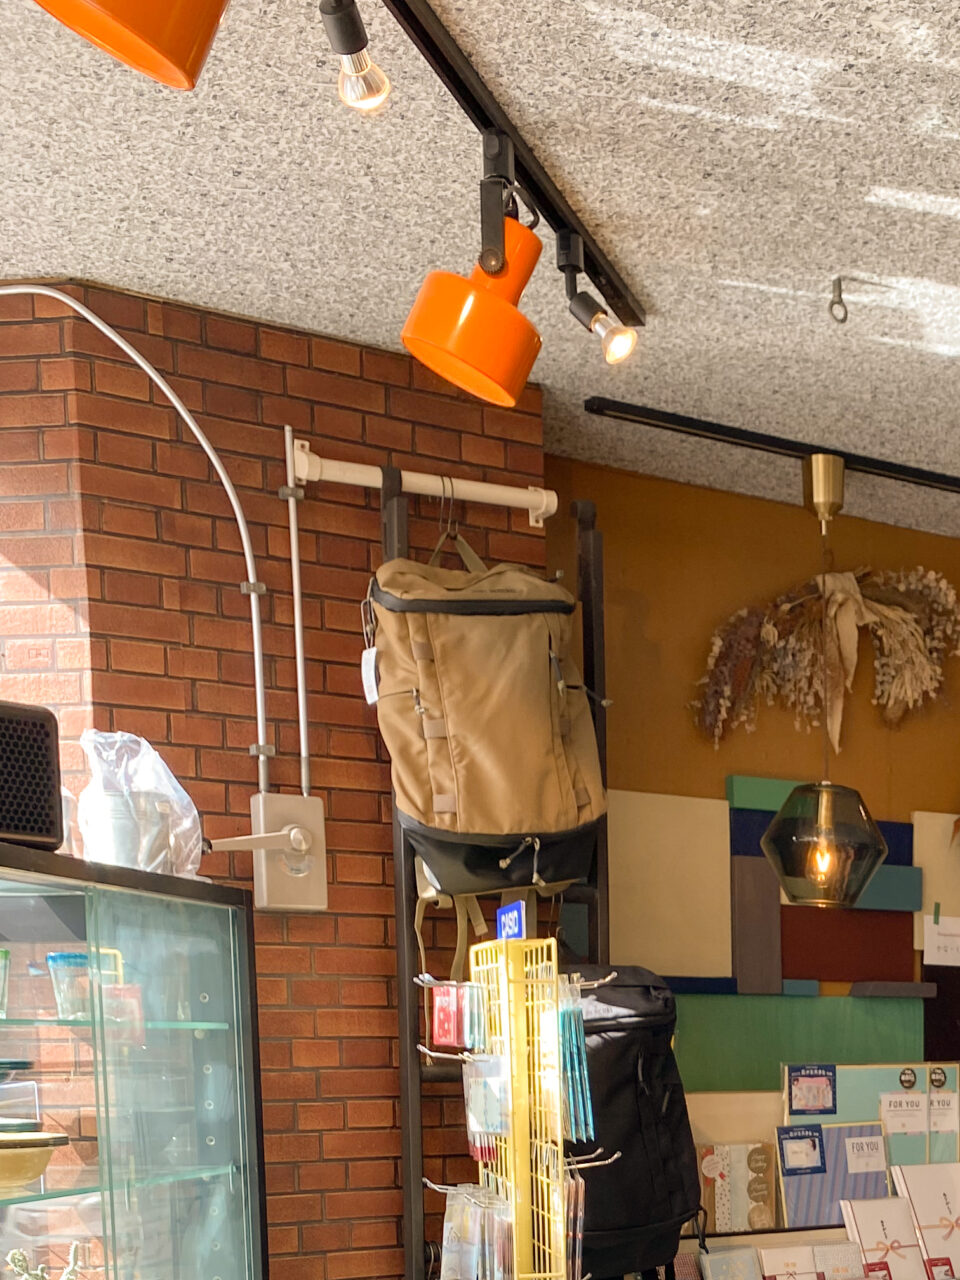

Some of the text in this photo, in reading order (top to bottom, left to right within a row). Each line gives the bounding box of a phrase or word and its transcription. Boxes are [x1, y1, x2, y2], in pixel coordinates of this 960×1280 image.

[501, 910, 519, 937] CASIO
[888, 1099, 903, 1109] FOR
[905, 1099, 920, 1108] YOU
[937, 1099, 951, 1108] YOU
[852, 1141, 879, 1152] FOR YOU
